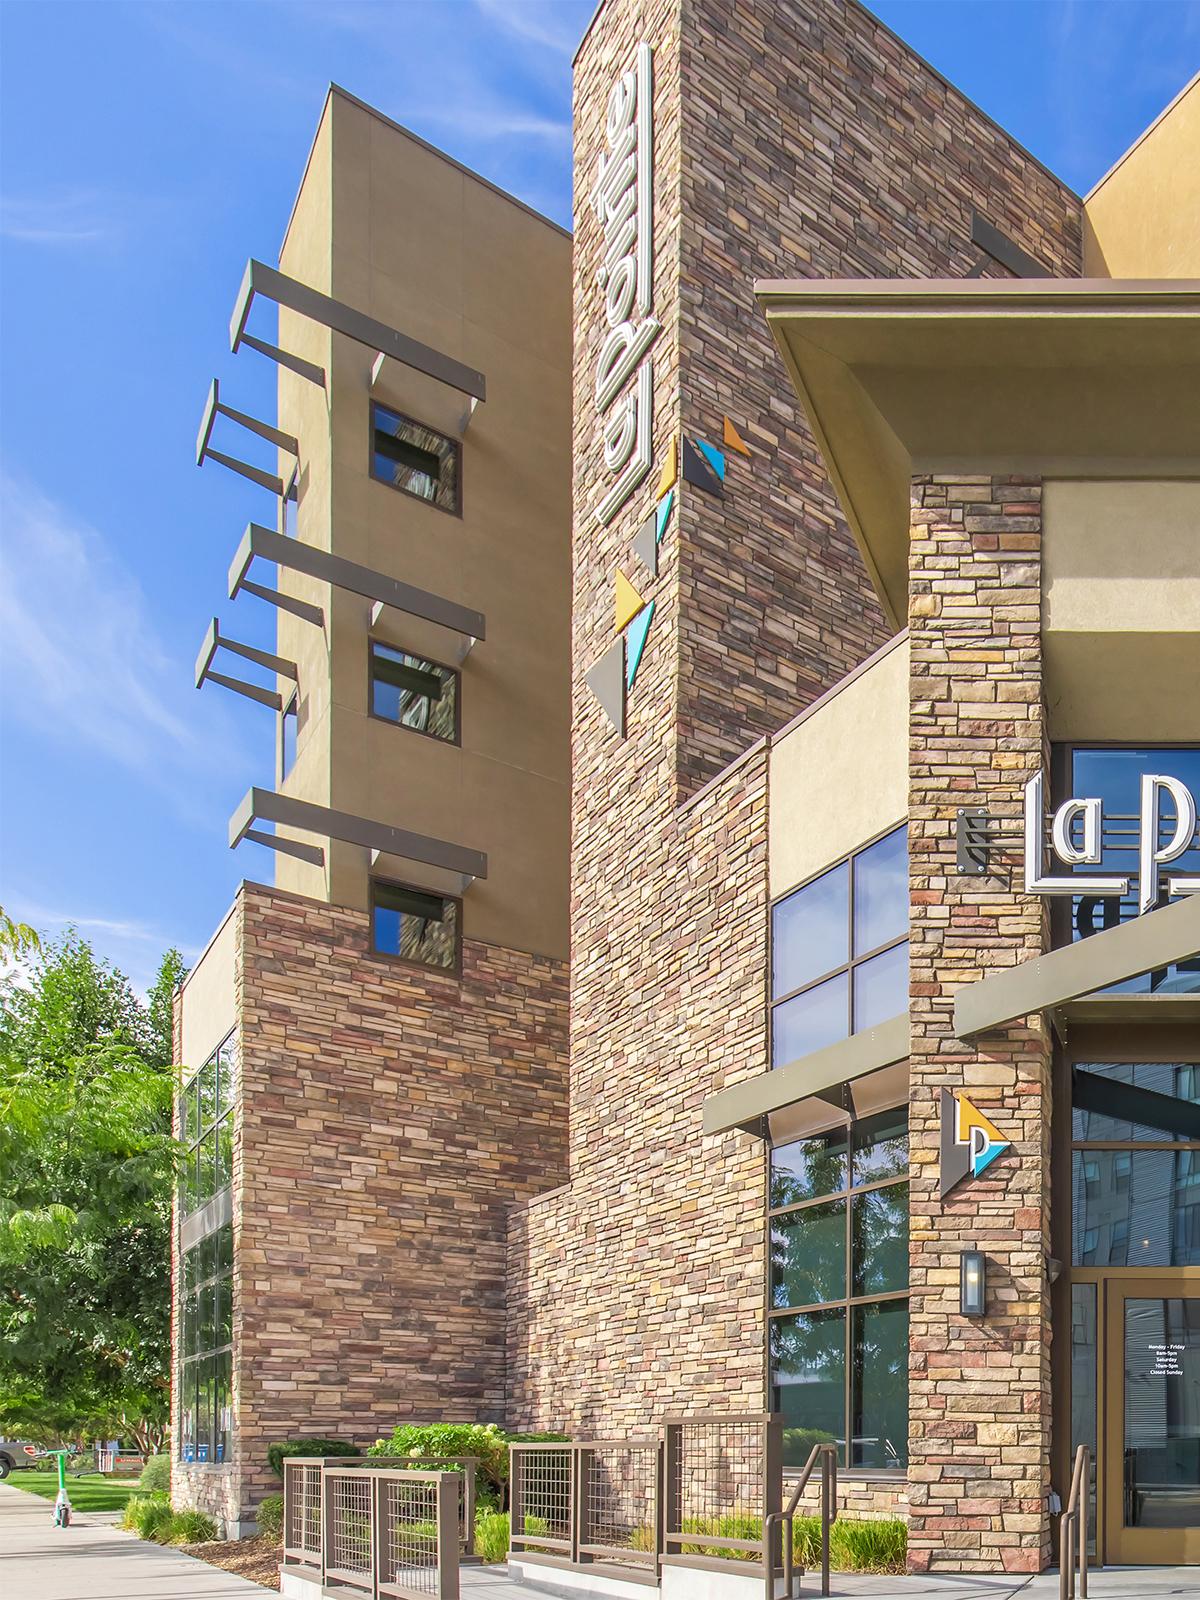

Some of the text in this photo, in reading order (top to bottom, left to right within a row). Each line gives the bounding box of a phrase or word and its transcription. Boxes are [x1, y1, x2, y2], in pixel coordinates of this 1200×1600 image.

[589, 70, 662, 526] La Pointe
[1024, 769, 1129, 895] La
